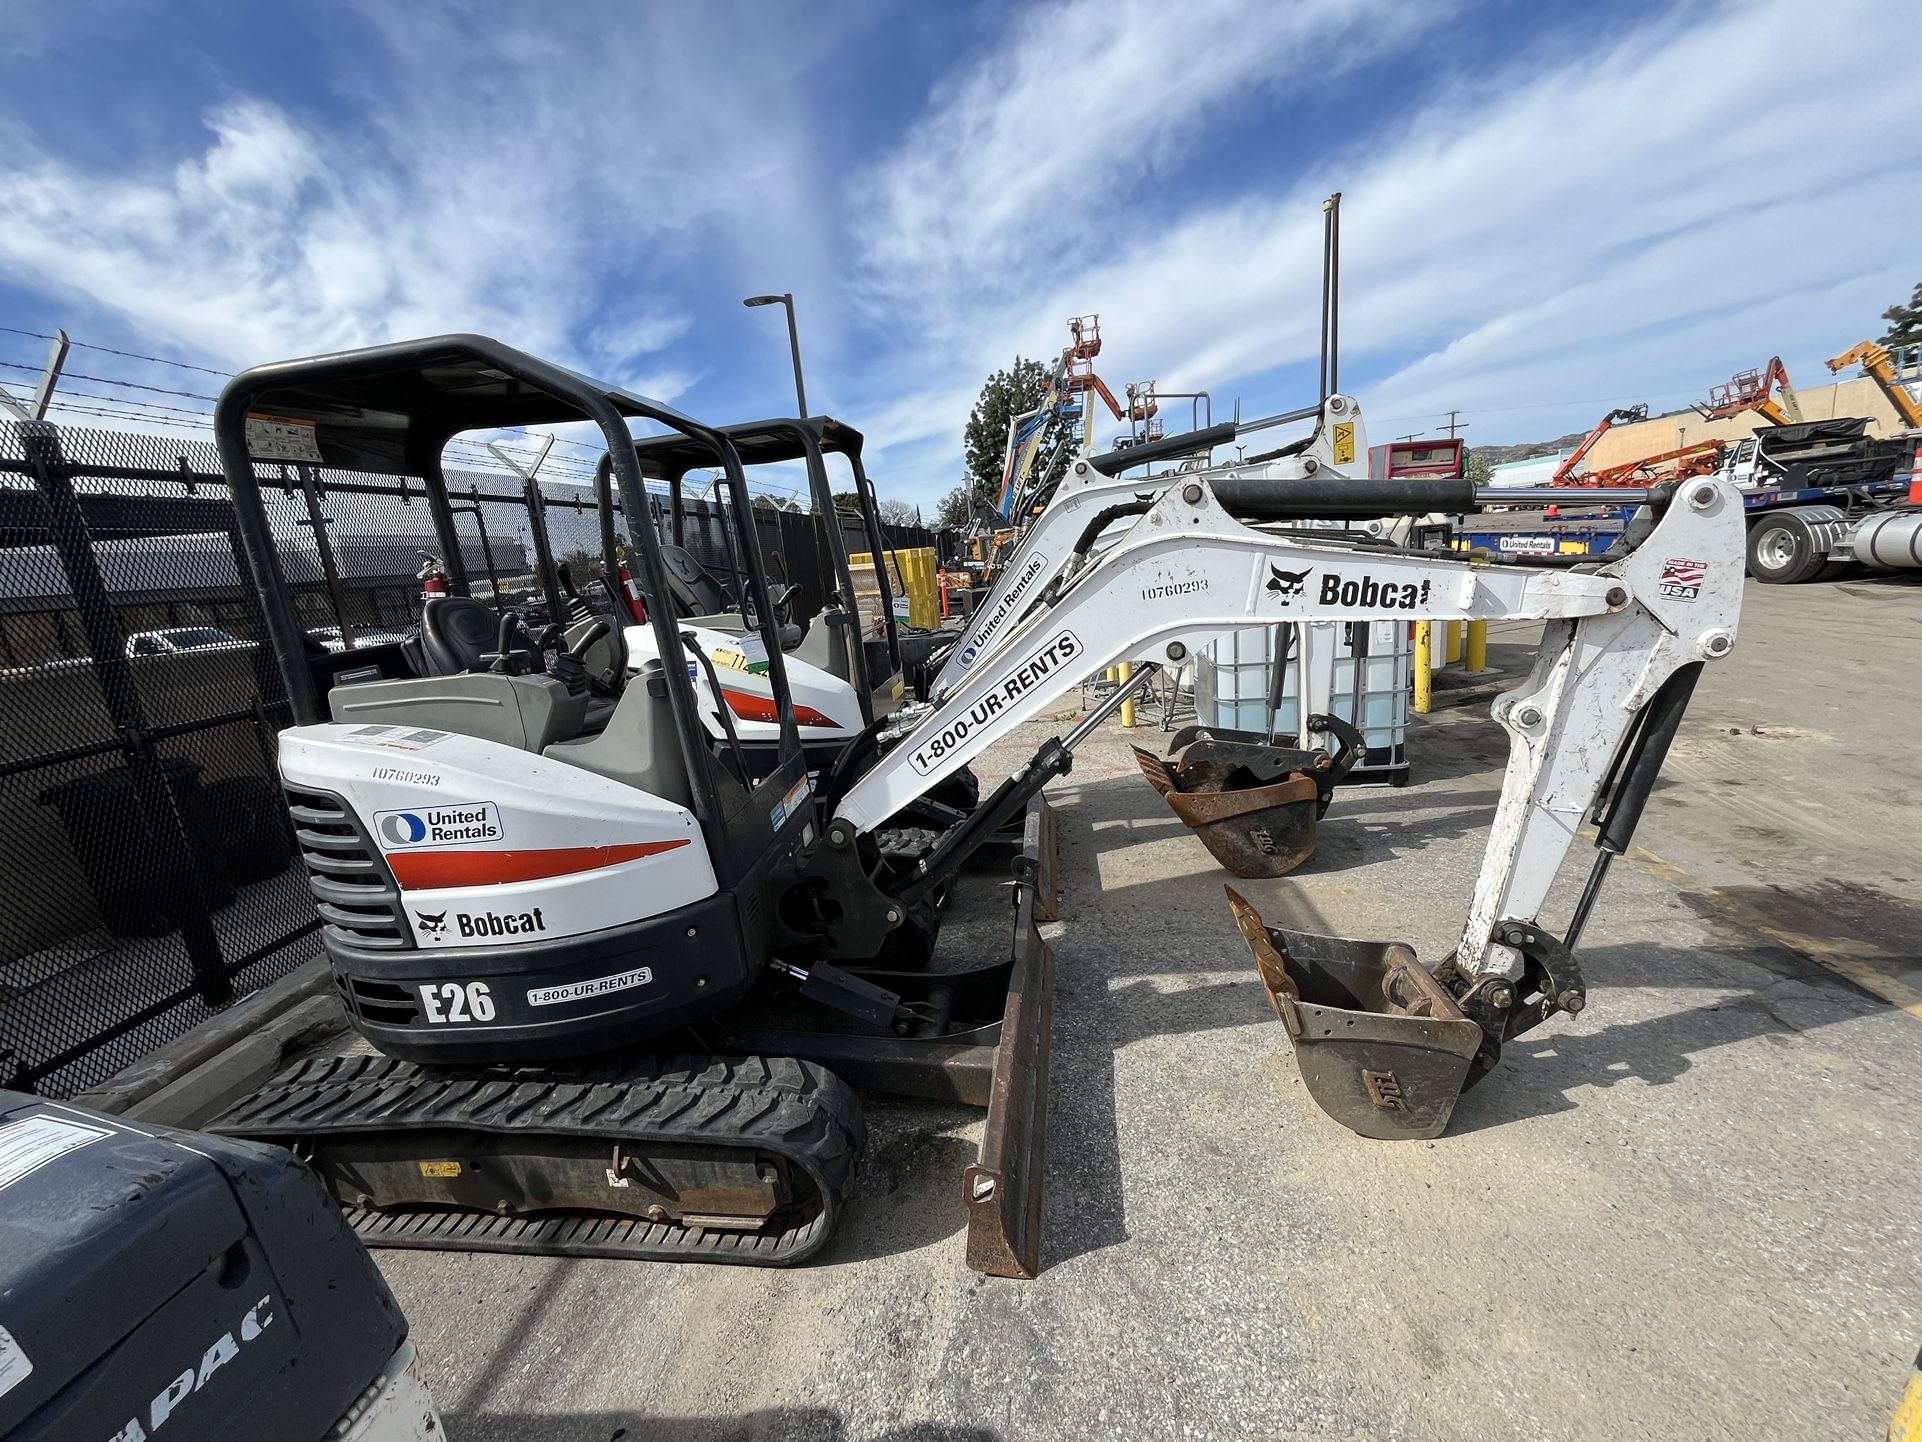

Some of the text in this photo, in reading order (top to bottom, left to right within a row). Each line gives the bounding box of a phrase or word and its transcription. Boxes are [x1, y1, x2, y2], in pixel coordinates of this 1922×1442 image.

[1510, 540, 1551, 549] United Rentals
[1142, 579, 1209, 600] 10760293
[1319, 573, 1432, 610] Bobcat
[1660, 585, 1695, 598] USA
[973, 560, 1041, 648] United Rentals
[915, 635, 1075, 769] 1-800-UR-RENTS
[372, 767, 441, 786] 10760293
[427, 807, 487, 826] United
[431, 823, 497, 841] Rentals
[456, 907, 546, 938] Bobcat
[418, 971, 647, 1024] E26 1-800-UR-RENTS
